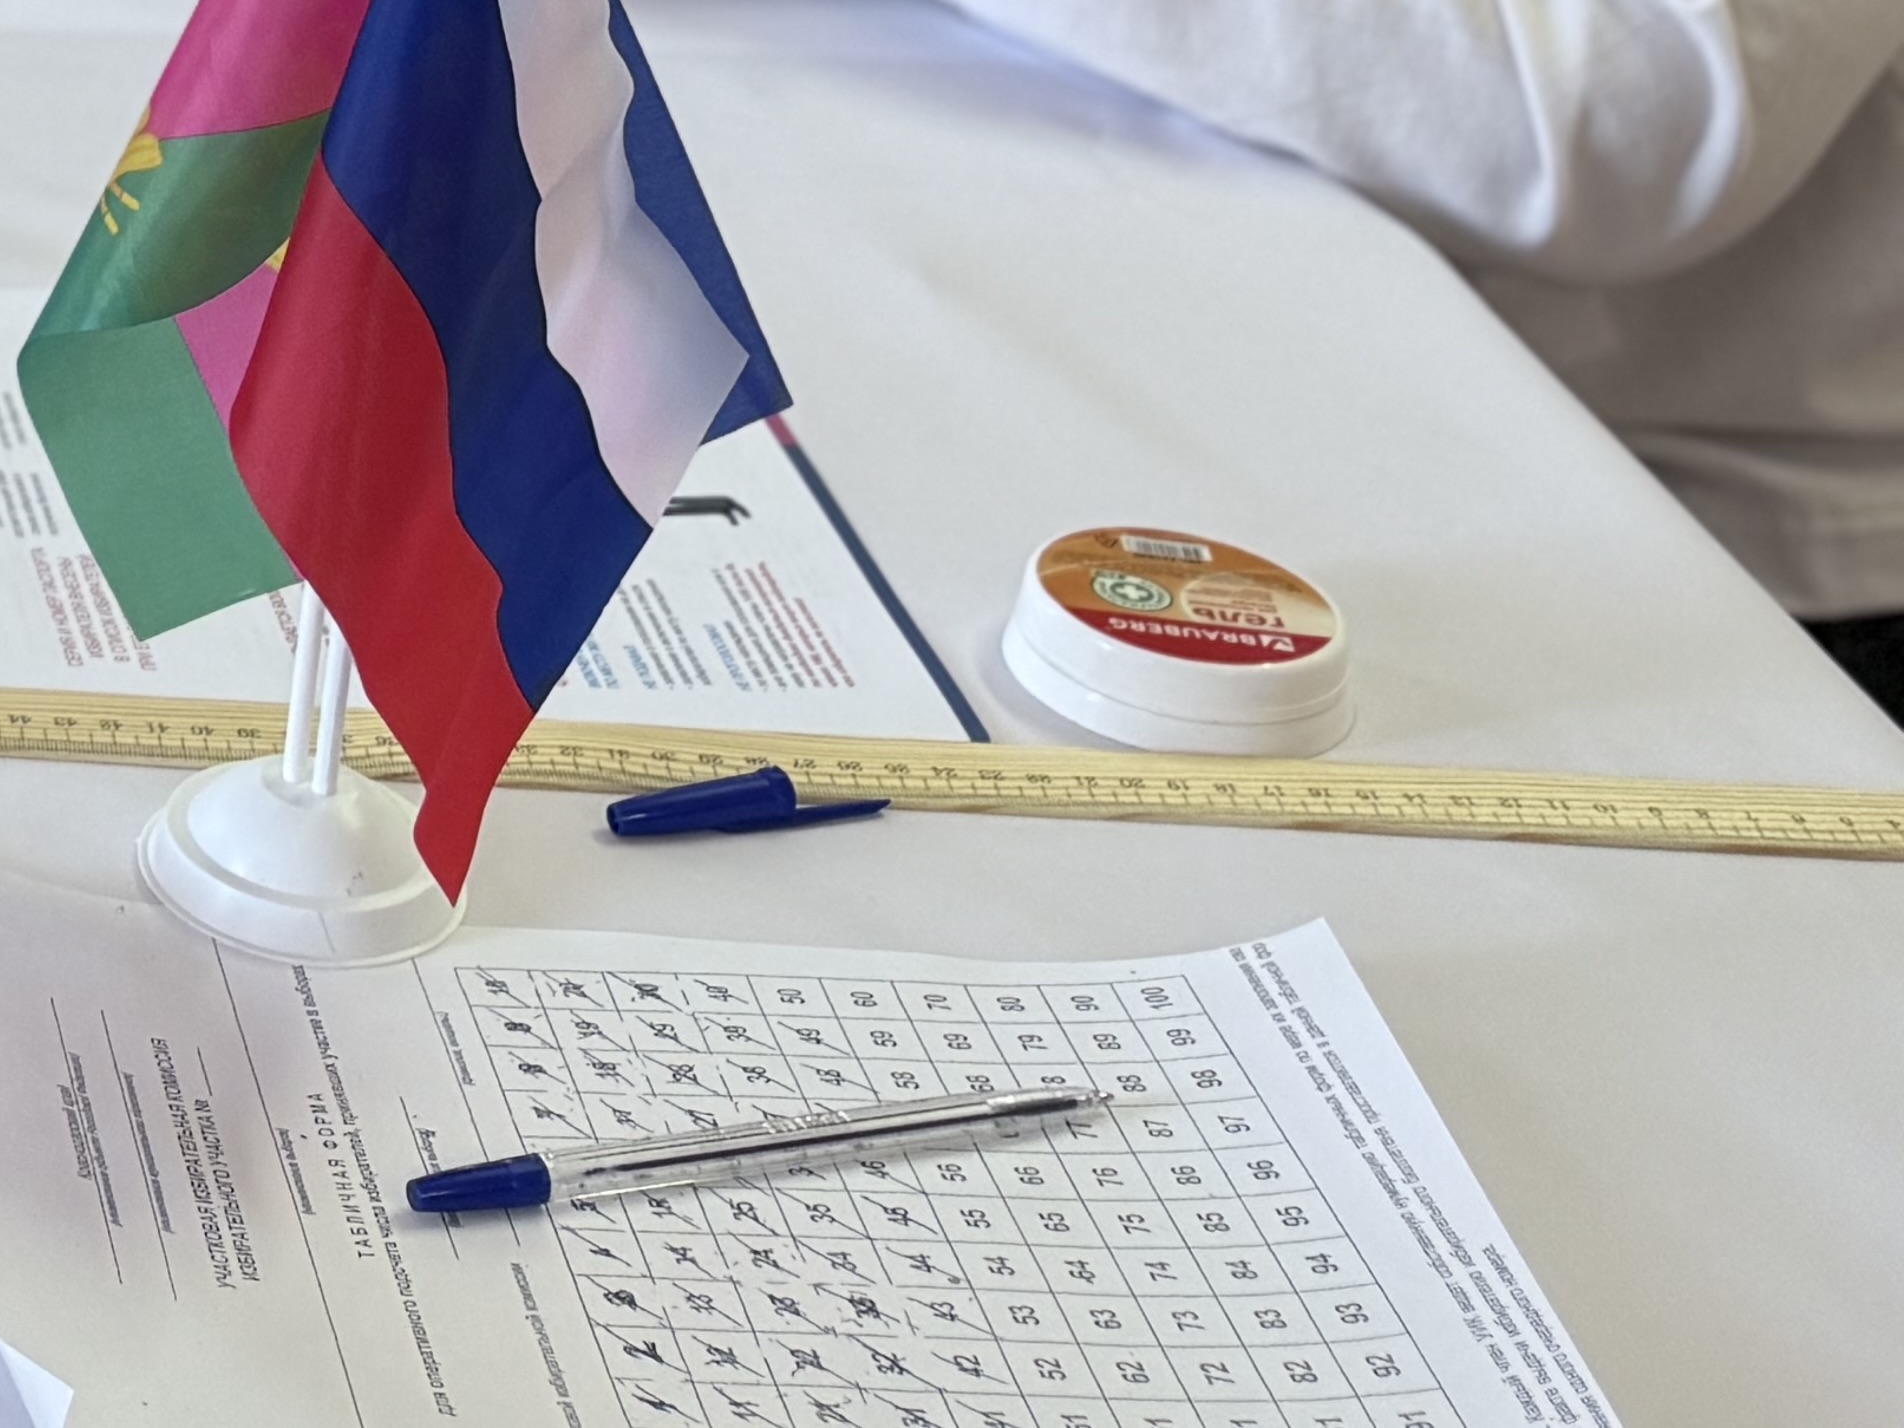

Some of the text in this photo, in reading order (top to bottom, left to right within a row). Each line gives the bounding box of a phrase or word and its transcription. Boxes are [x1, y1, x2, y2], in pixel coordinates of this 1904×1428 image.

[1108, 617, 1256, 647] BRAUBERG
[778, 989, 805, 1004] 50
[997, 997, 1024, 1011] 80
[1141, 987, 1174, 1010] 100
[308, 1018, 338, 1060] участие
[1018, 1034, 1048, 1050] 79
[1167, 1029, 1196, 1046] 99
[1296, 1051, 1311, 1063] по
[1191, 1070, 1222, 1088] 98
[323, 1062, 358, 1125] принявших
[1219, 1115, 1251, 1133] 97
[150, 1037, 236, 1289] УЧАСТКОВАЯ ИЗБИРАТЕЛЬНАЯ КОМИССИЯ
[1247, 1160, 1280, 1180] 96
[306, 1093, 375, 1259] ТАБЛИЧНАЯ ФОРМА
[851, 991, 1067, 1380] 52 53 54 55 56 58 59 60
[1093, 1168, 1124, 1187] 76
[194, 1099, 260, 1281] ИЗБИРАТЕЛЬНОГО УЧАСТКА №
[924, 994, 1150, 1383] 62 63 64 65 66 68 69 70
[1071, 996, 1318, 1382] 82 83 84 85 86 87 88 89 90
[370, 1206, 393, 1238] числа
[1117, 1214, 1151, 1234] 75
[1275, 1206, 1309, 1226] 95
[384, 1241, 413, 1297] подсчета
[1145, 1261, 1177, 1281] 74
[1305, 1253, 1339, 1273] 94
[1171, 1310, 1205, 1331] 73
[1335, 1302, 1369, 1324] 93
[1463, 1315, 1494, 1342] УИК
[403, 1300, 442, 1388] оперативного
[1365, 1353, 1401, 1377] 92
[1486, 1343, 1512, 1371] член
[1516, 1341, 1553, 1384] выдачи
[1200, 1362, 1234, 1385] 72
[433, 1392, 457, 1417] для
[1502, 1375, 1545, 1423] Каждый
